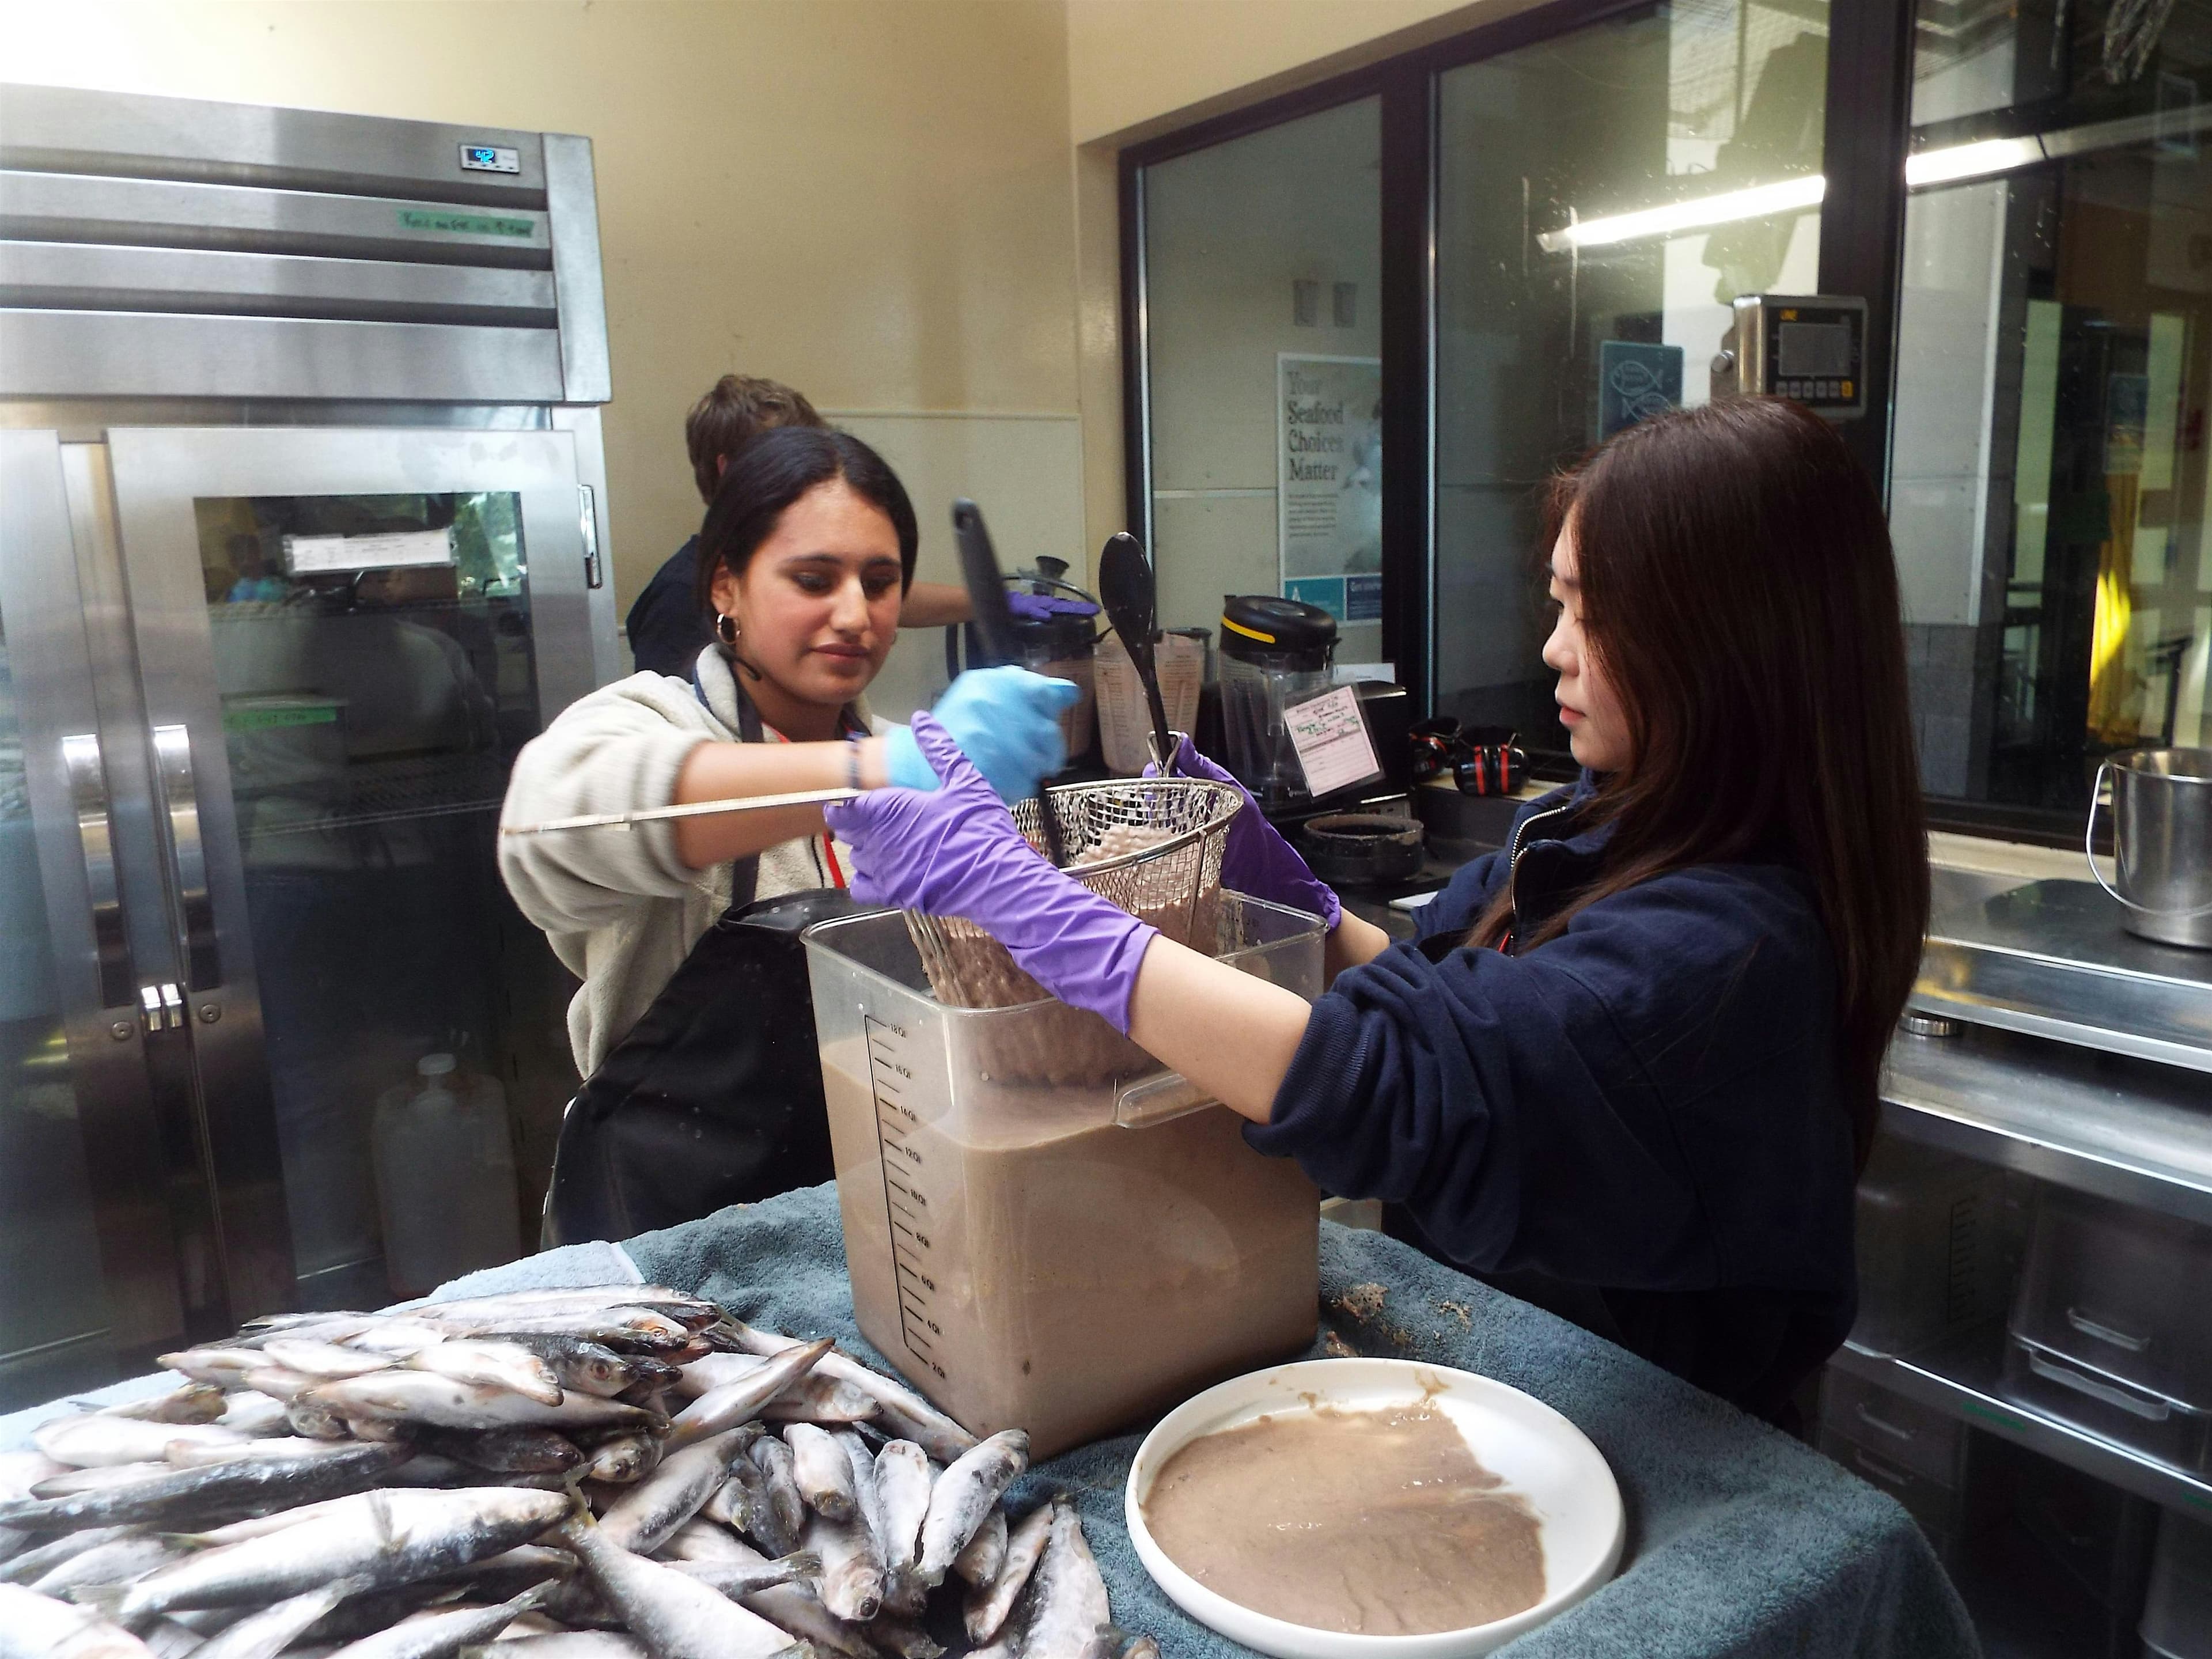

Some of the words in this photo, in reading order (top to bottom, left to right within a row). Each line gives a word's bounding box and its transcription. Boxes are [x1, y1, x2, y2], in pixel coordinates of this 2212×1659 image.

[476, 149, 494, 164] 42
[1287, 371, 1323, 396] Your
[1287, 400, 1344, 425] Seafood
[1288, 429, 1344, 453] Choices
[1288, 458, 1338, 481] Matter
